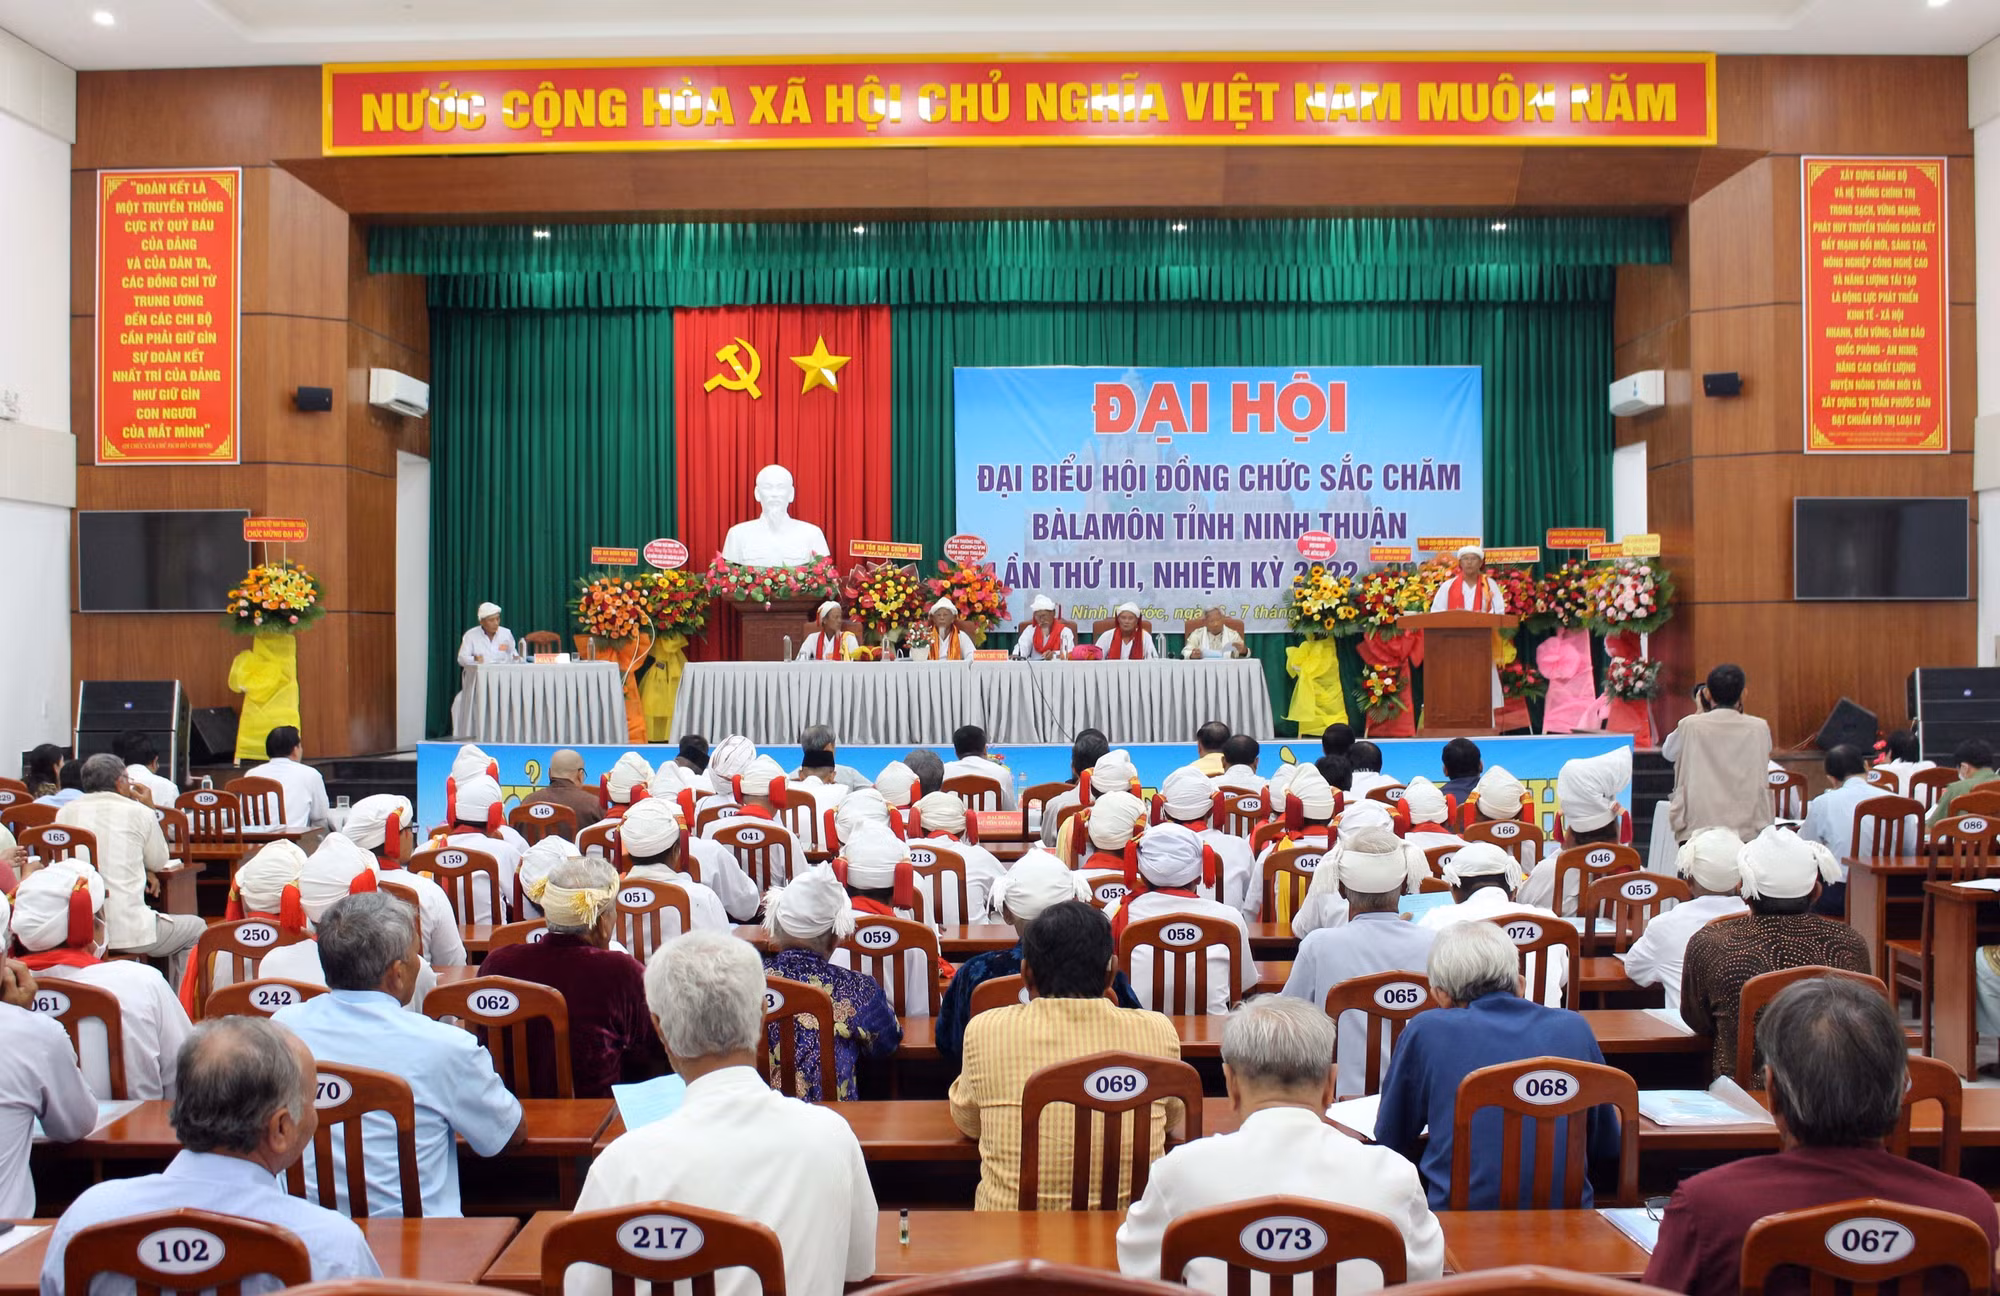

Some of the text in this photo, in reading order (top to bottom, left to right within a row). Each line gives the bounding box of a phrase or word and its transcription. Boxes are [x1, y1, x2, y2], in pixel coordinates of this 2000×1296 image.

[363, 71, 1677, 137] NƯỚC CỘNG HÒA XÃ HỘI CHỦ NGHĨA VIỆT NAM MUÔN NĂM
[1092, 373, 1346, 443] ĐẠI HỘI
[978, 454, 1460, 497] ĐẠI BIỂU HỘI ĐỒNG CHỨC SẮC CHĂM
[1034, 504, 1406, 545] BÀLAMÔN TỈNH NINH THUẬN
[992, 552, 1041, 589] ẦN
[1050, 556, 1103, 588] THỨ
[1111, 562, 1143, 592] III,
[1154, 556, 1240, 594] NHIỆM
[1252, 556, 1284, 589] KỲ
[1071, 604, 1108, 619] Ninh
[1174, 604, 1204, 622] ngà
[1241, 605, 1250, 619] 7
[199, 795, 214, 803] 199
[1243, 801, 1259, 809] 193
[534, 807, 550, 816] 146
[1497, 826, 1515, 835] 166
[1964, 821, 1983, 830] 086
[48, 833, 65, 842] 165
[741, 832, 759, 841] 041
[443, 855, 462, 864] 159
[910, 853, 931, 863] 213
[1591, 852, 1611, 863] 046
[1102, 888, 1125, 898] 053
[1627, 885, 1652, 896] 055
[625, 892, 648, 903] 051
[243, 929, 269, 941] 250
[863, 931, 891, 943] 059
[1168, 928, 1195, 940] 058
[1508, 927, 1535, 938] 074
[259, 991, 291, 1005] 242
[1384, 988, 1417, 1003] 065
[477, 996, 509, 1009] 062
[1096, 1075, 1136, 1093] 069
[1526, 1079, 1567, 1096] 068
[315, 1082, 341, 1100] 70
[633, 1226, 687, 1249] 217
[1256, 1228, 1312, 1250] 073
[1842, 1229, 1899, 1253] 067
[157, 1239, 209, 1262] 102
